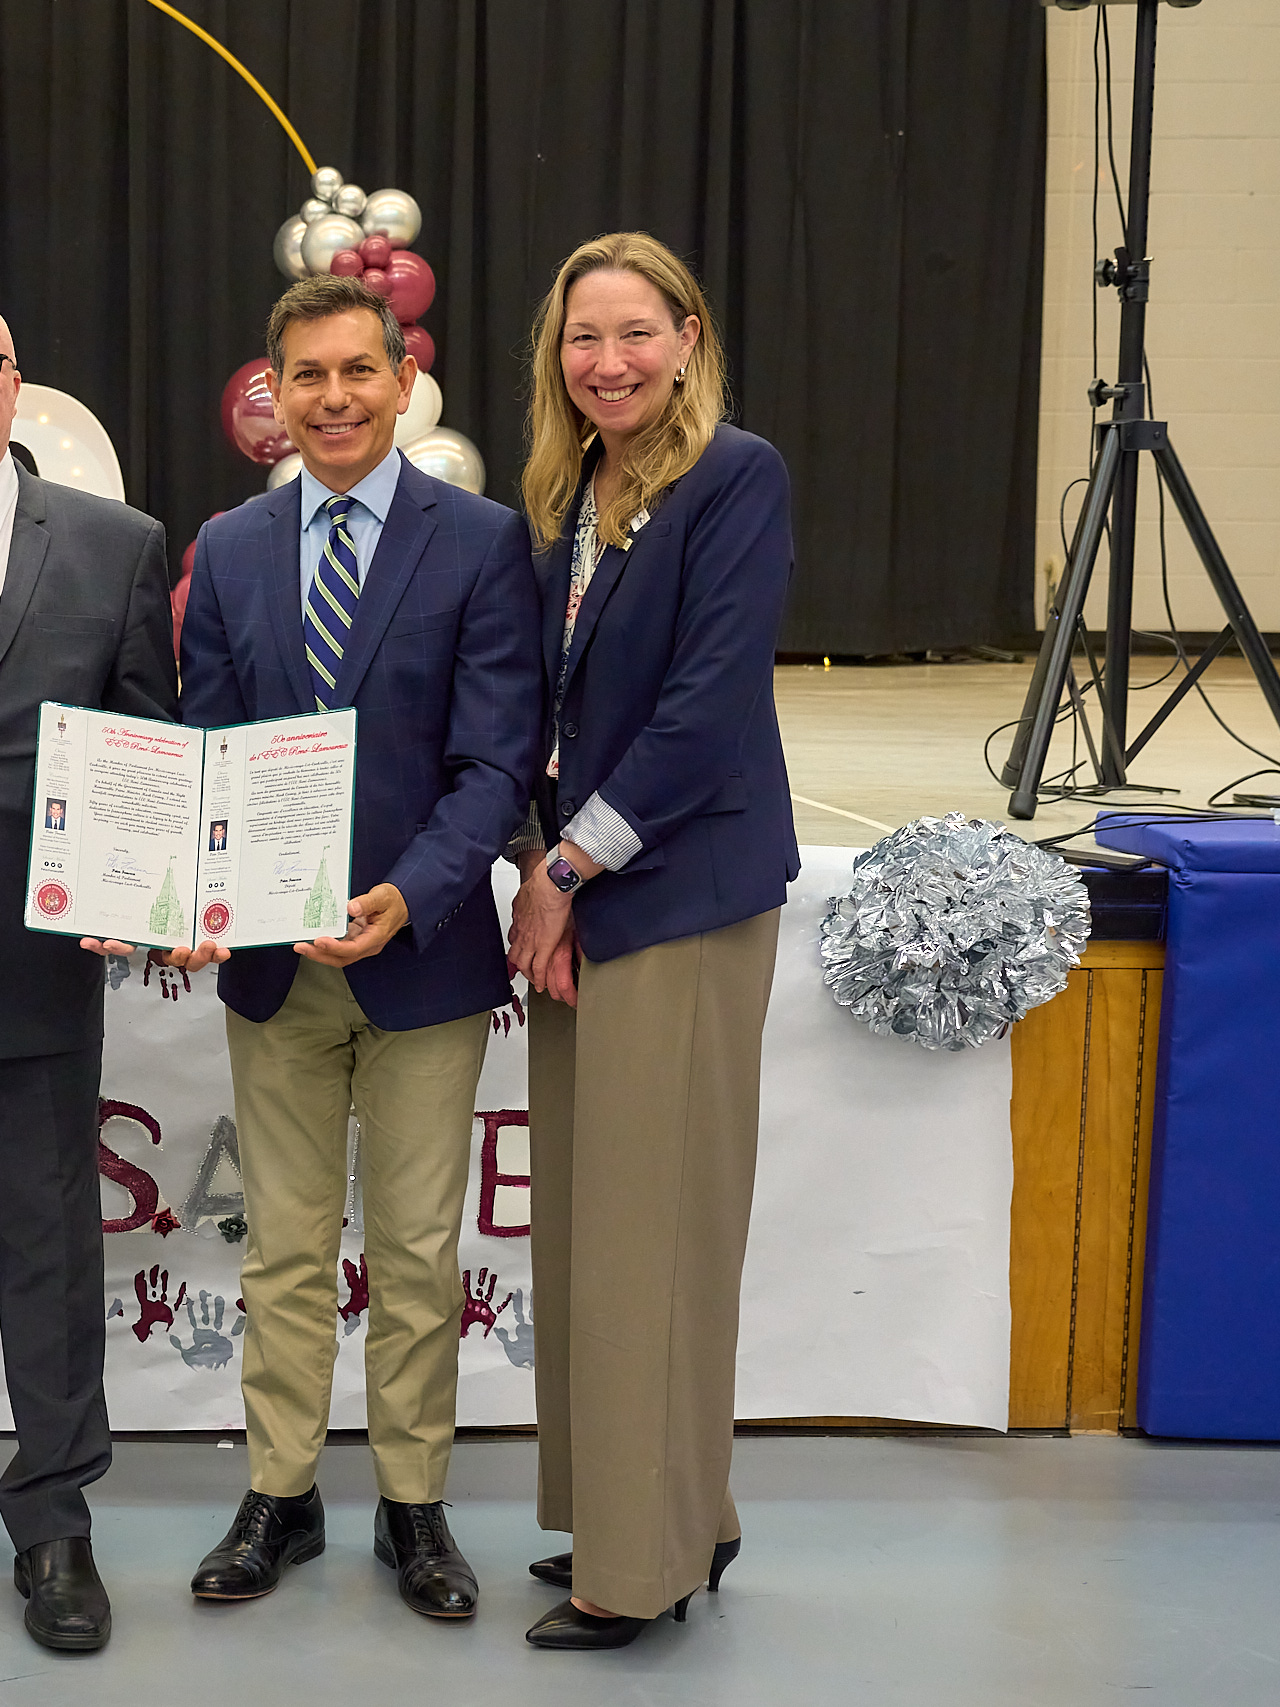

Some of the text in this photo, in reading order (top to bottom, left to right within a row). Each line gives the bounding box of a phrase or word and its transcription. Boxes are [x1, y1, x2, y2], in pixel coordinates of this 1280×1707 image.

[117, 728, 154, 744] Anniversary
[154, 737, 181, 747] celebration
[182, 741, 189, 749] of
[286, 731, 328, 742] anniversaire
